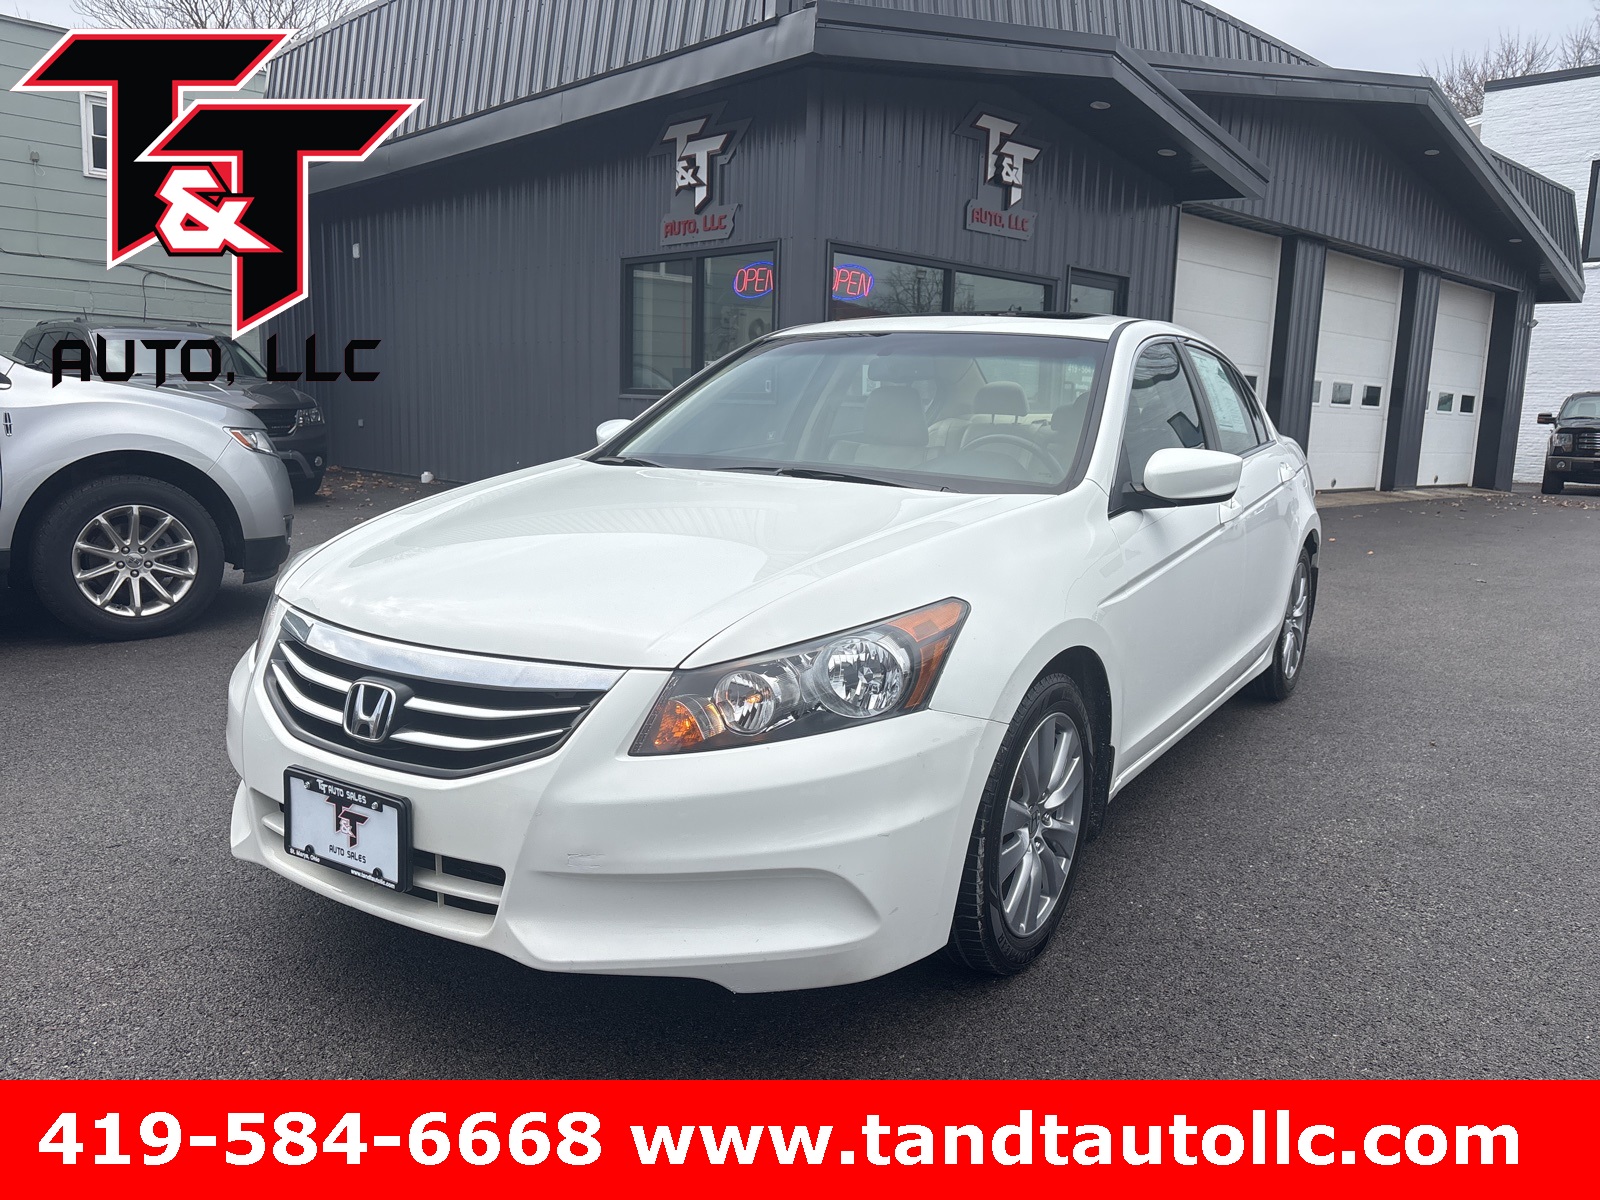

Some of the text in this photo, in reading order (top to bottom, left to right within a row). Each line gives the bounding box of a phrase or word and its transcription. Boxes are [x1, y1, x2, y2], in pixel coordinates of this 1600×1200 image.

[664, 214, 728, 238] AUTO, LLC
[971, 207, 1029, 232] AUTO, LLC
[735, 267, 773, 292] OPEN
[328, 785, 344, 797] AUTO
[346, 791, 367, 804] SALES
[328, 844, 367, 864] AUTO SALES
